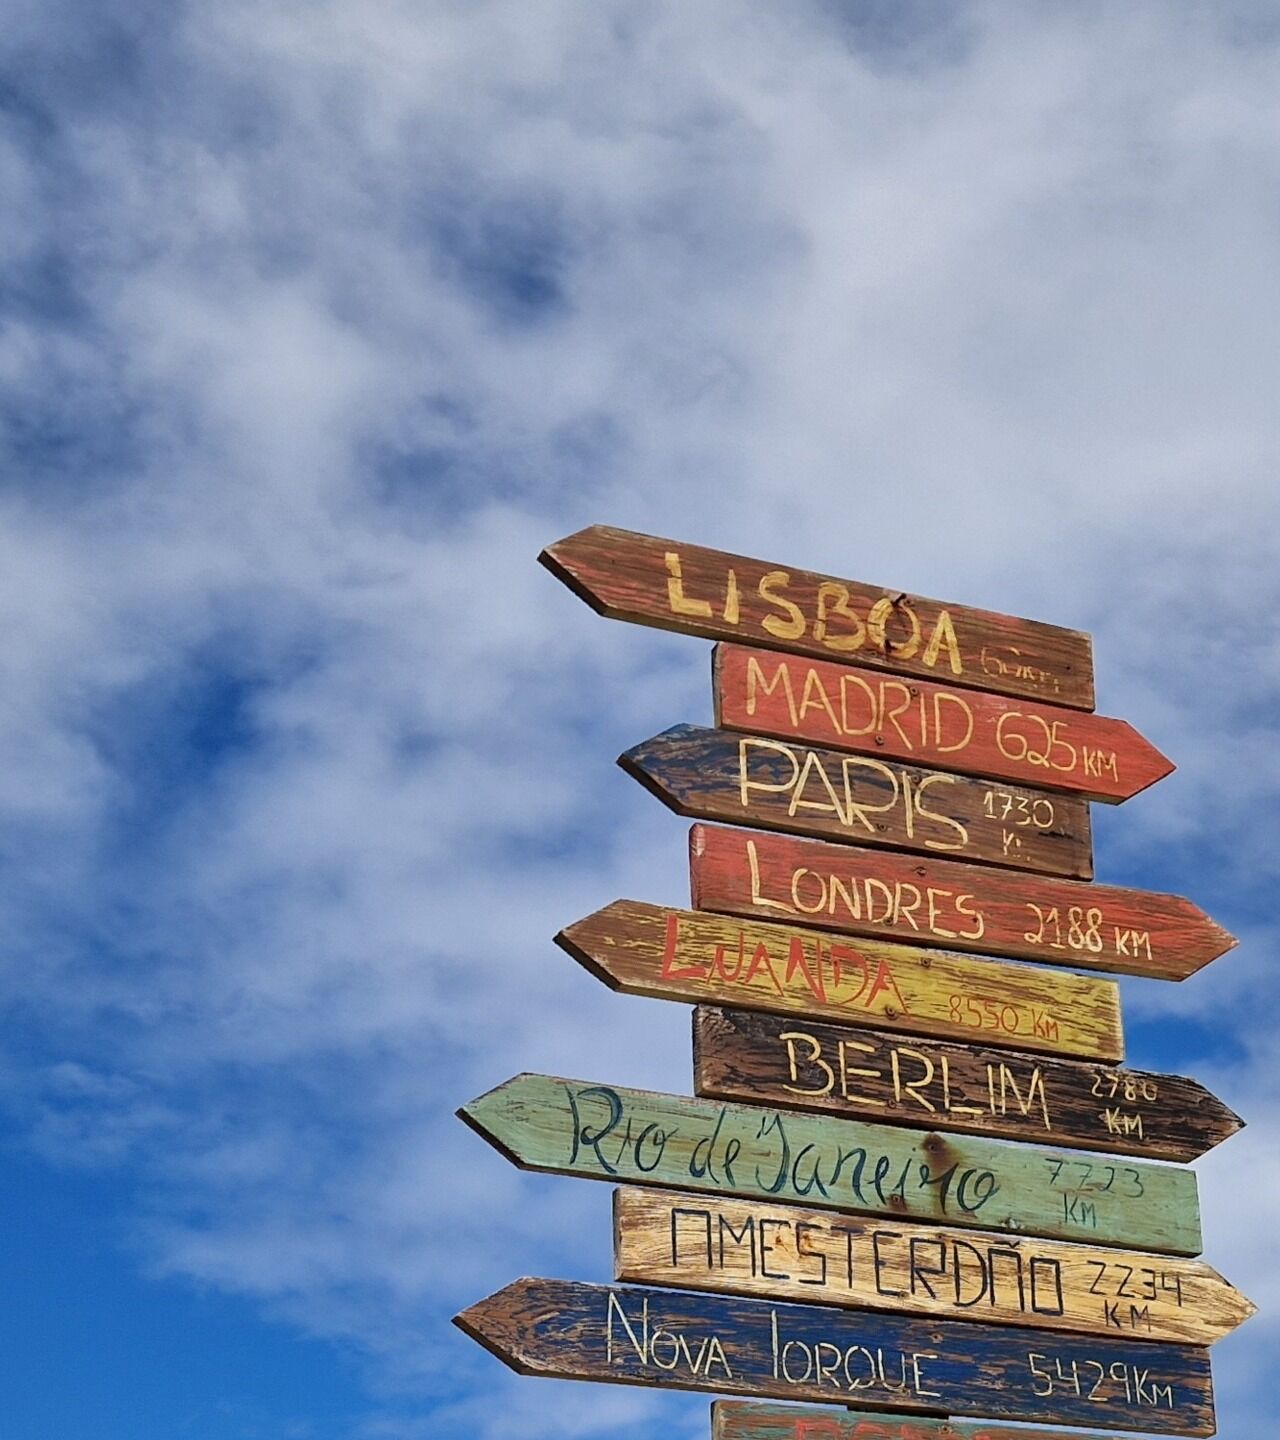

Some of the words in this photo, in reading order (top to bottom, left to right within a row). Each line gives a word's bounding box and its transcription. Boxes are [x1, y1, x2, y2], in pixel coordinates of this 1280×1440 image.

[664, 551, 963, 675] LISBOA
[746, 656, 974, 752] MADRID
[995, 711, 1077, 772] 625
[1083, 745, 1118, 782] KM
[739, 738, 969, 850] PARIS
[983, 791, 1055, 829] 1730
[746, 840, 986, 941] LONDRES
[1023, 902, 1104, 952] 2188
[1115, 926, 1152, 961] KM
[661, 913, 914, 1026] LUANDA
[949, 994, 1019, 1034] 8550
[779, 1032, 1052, 1132] BERLIM
[1105, 1106, 1144, 1140] KM
[565, 1084, 680, 1175] Rio
[689, 1106, 742, 1188] de
[755, 1113, 1001, 1215] Janeiro
[1045, 1157, 1145, 1199] 7723
[1063, 1192, 1097, 1229] KM
[1086, 1260, 1184, 1308] 2234
[1103, 1299, 1152, 1333] KM
